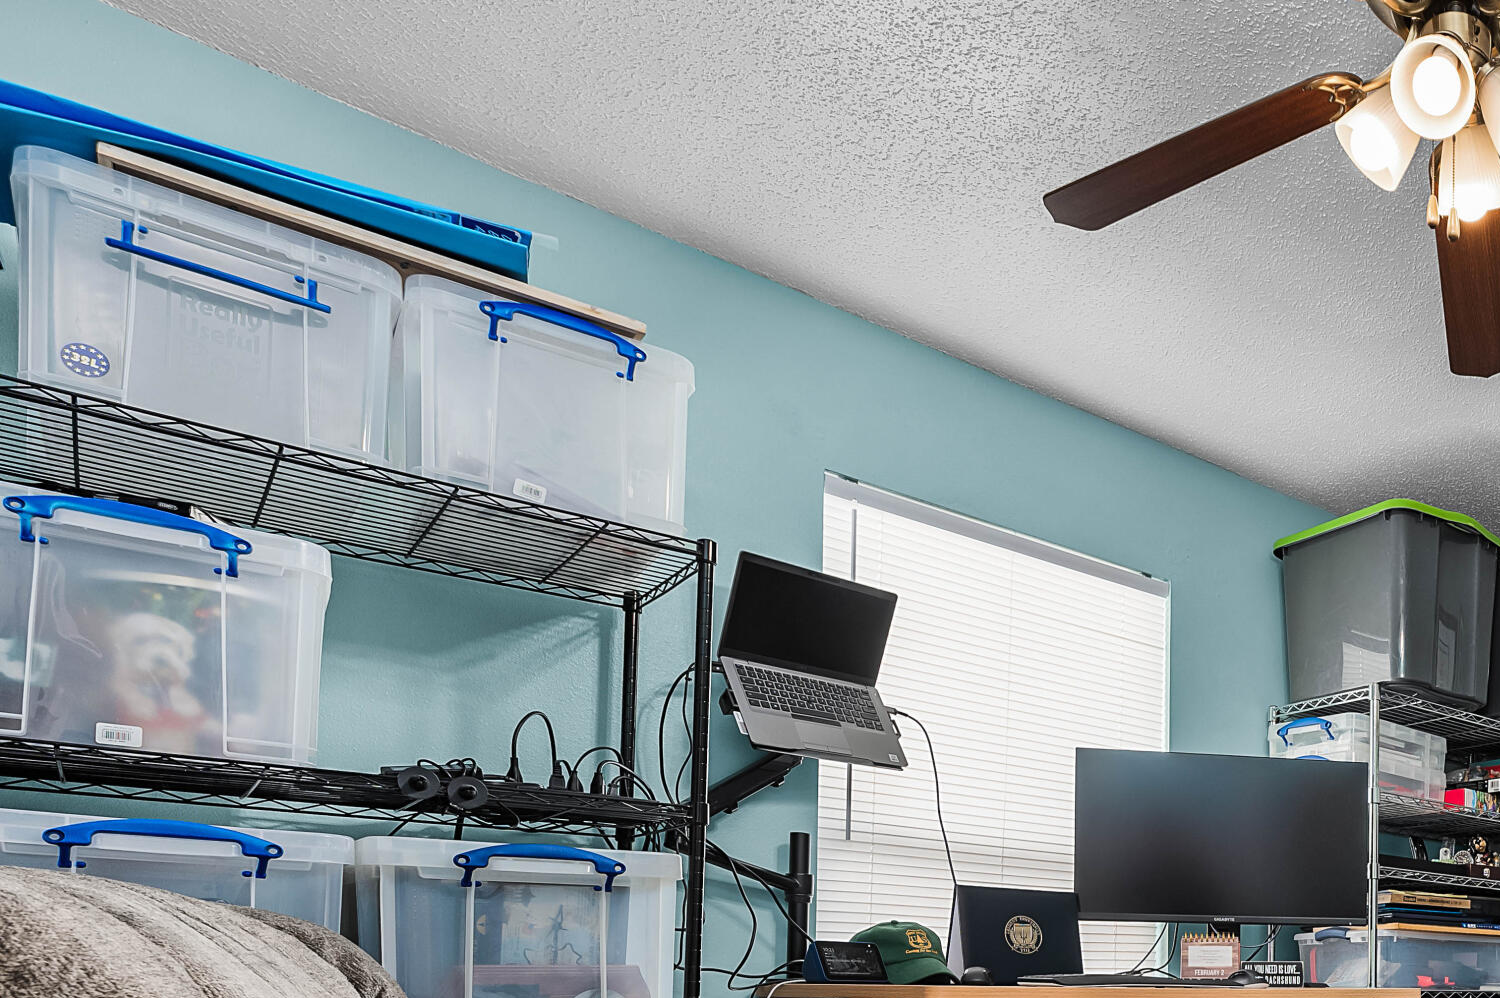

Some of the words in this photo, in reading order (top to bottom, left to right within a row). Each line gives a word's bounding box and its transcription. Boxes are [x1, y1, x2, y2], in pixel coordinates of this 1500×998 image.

[70, 351, 99, 369] 32L
[1254, 964, 1264, 974] YOU
[1264, 964, 1277, 974] NEED
[1278, 964, 1284, 974] IS
